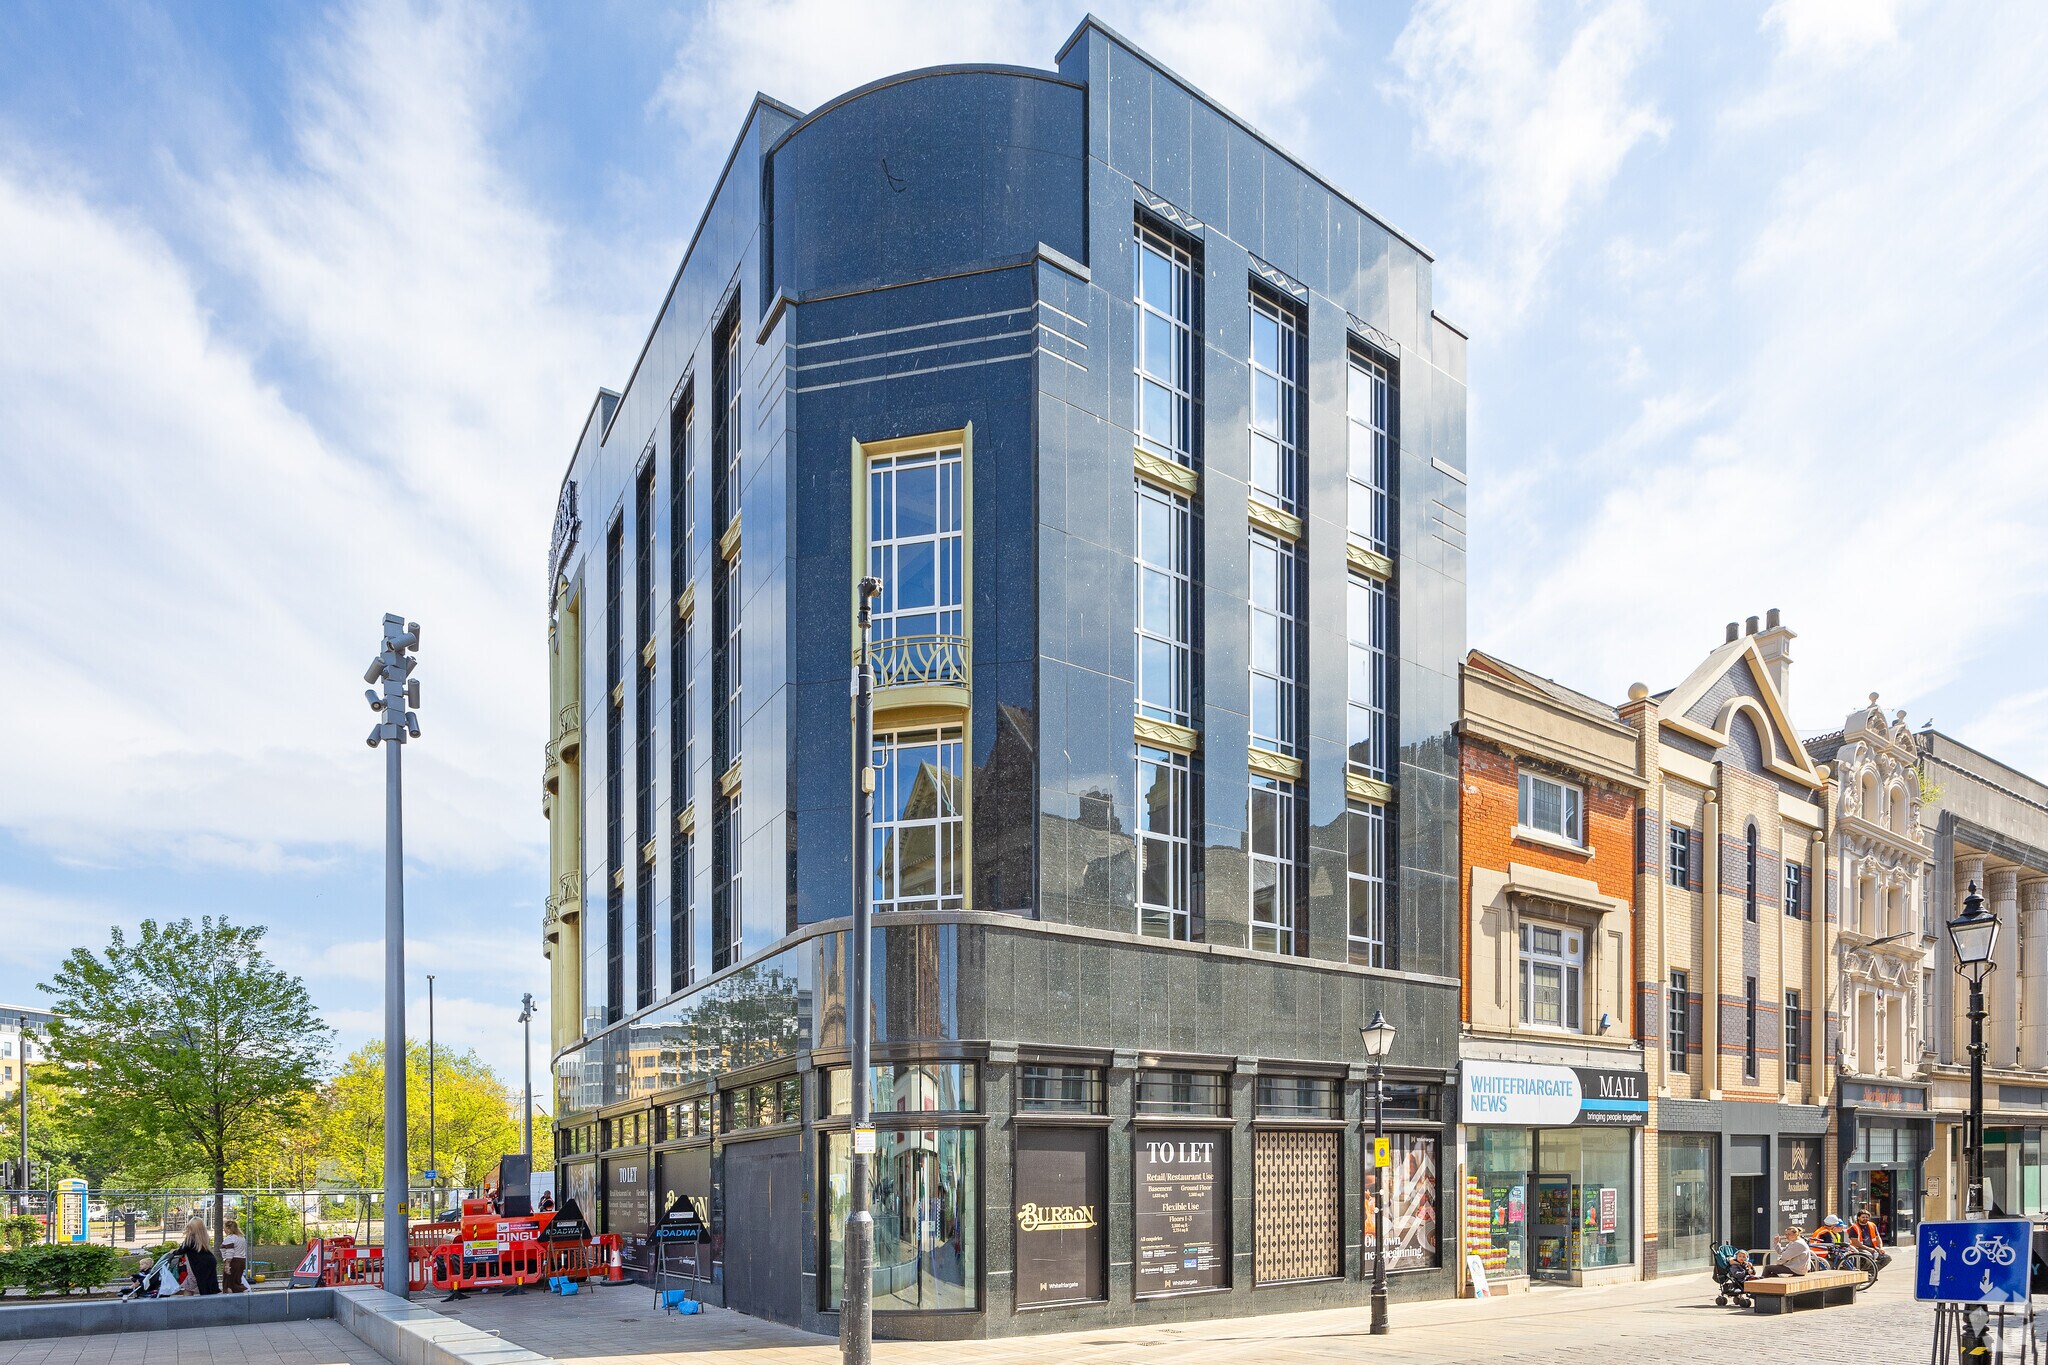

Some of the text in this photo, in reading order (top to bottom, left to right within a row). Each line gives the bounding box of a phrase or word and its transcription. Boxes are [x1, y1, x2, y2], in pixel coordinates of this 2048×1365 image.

[1470, 1075, 1573, 1097] WHITEFRIARGATE
[1599, 1075, 1639, 1098] MAIL
[1471, 1095, 1507, 1113] NEWS
[1587, 1112, 1642, 1122] bringing people together
[1146, 1141, 1214, 1164] TO LET
[619, 1166, 638, 1183] TO LET
[1146, 1172, 1214, 1182] Retail/Restaurant Use
[1783, 1170, 1798, 1181] Retail
[1788, 1181, 1809, 1192] Available
[1162, 1202, 1200, 1211] Flexible Use
[1017, 1203, 1097, 1231] BURTON
[1365, 1251, 1375, 1260] ne
